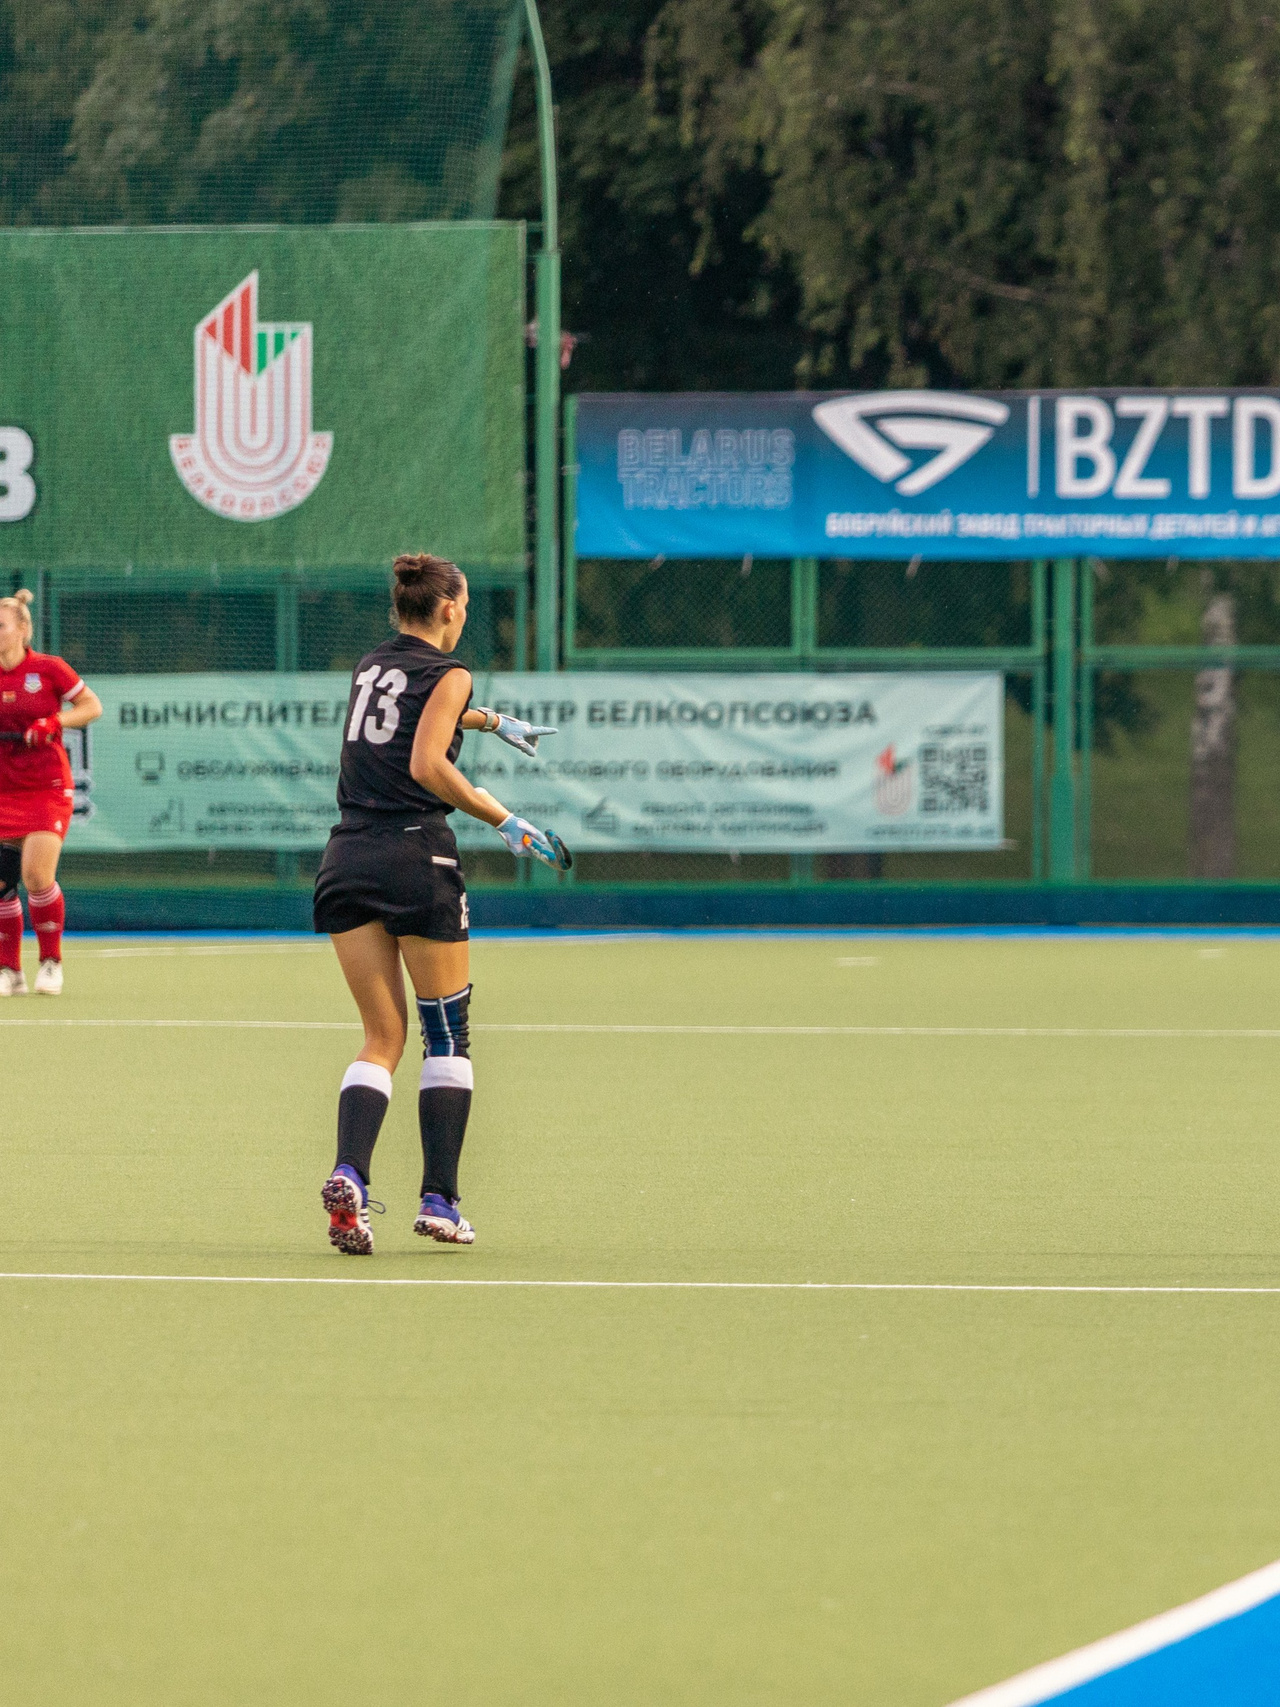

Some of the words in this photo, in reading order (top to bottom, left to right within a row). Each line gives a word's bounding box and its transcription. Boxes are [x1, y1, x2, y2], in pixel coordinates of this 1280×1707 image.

[617, 428, 796, 466] BELARUS
[621, 470, 795, 510] TRACTORS
[118, 700, 346, 728] ВЫЧИСЛИТЕЛ
[493, 699, 578, 724] ЕНТР
[347, 664, 408, 745] 13
